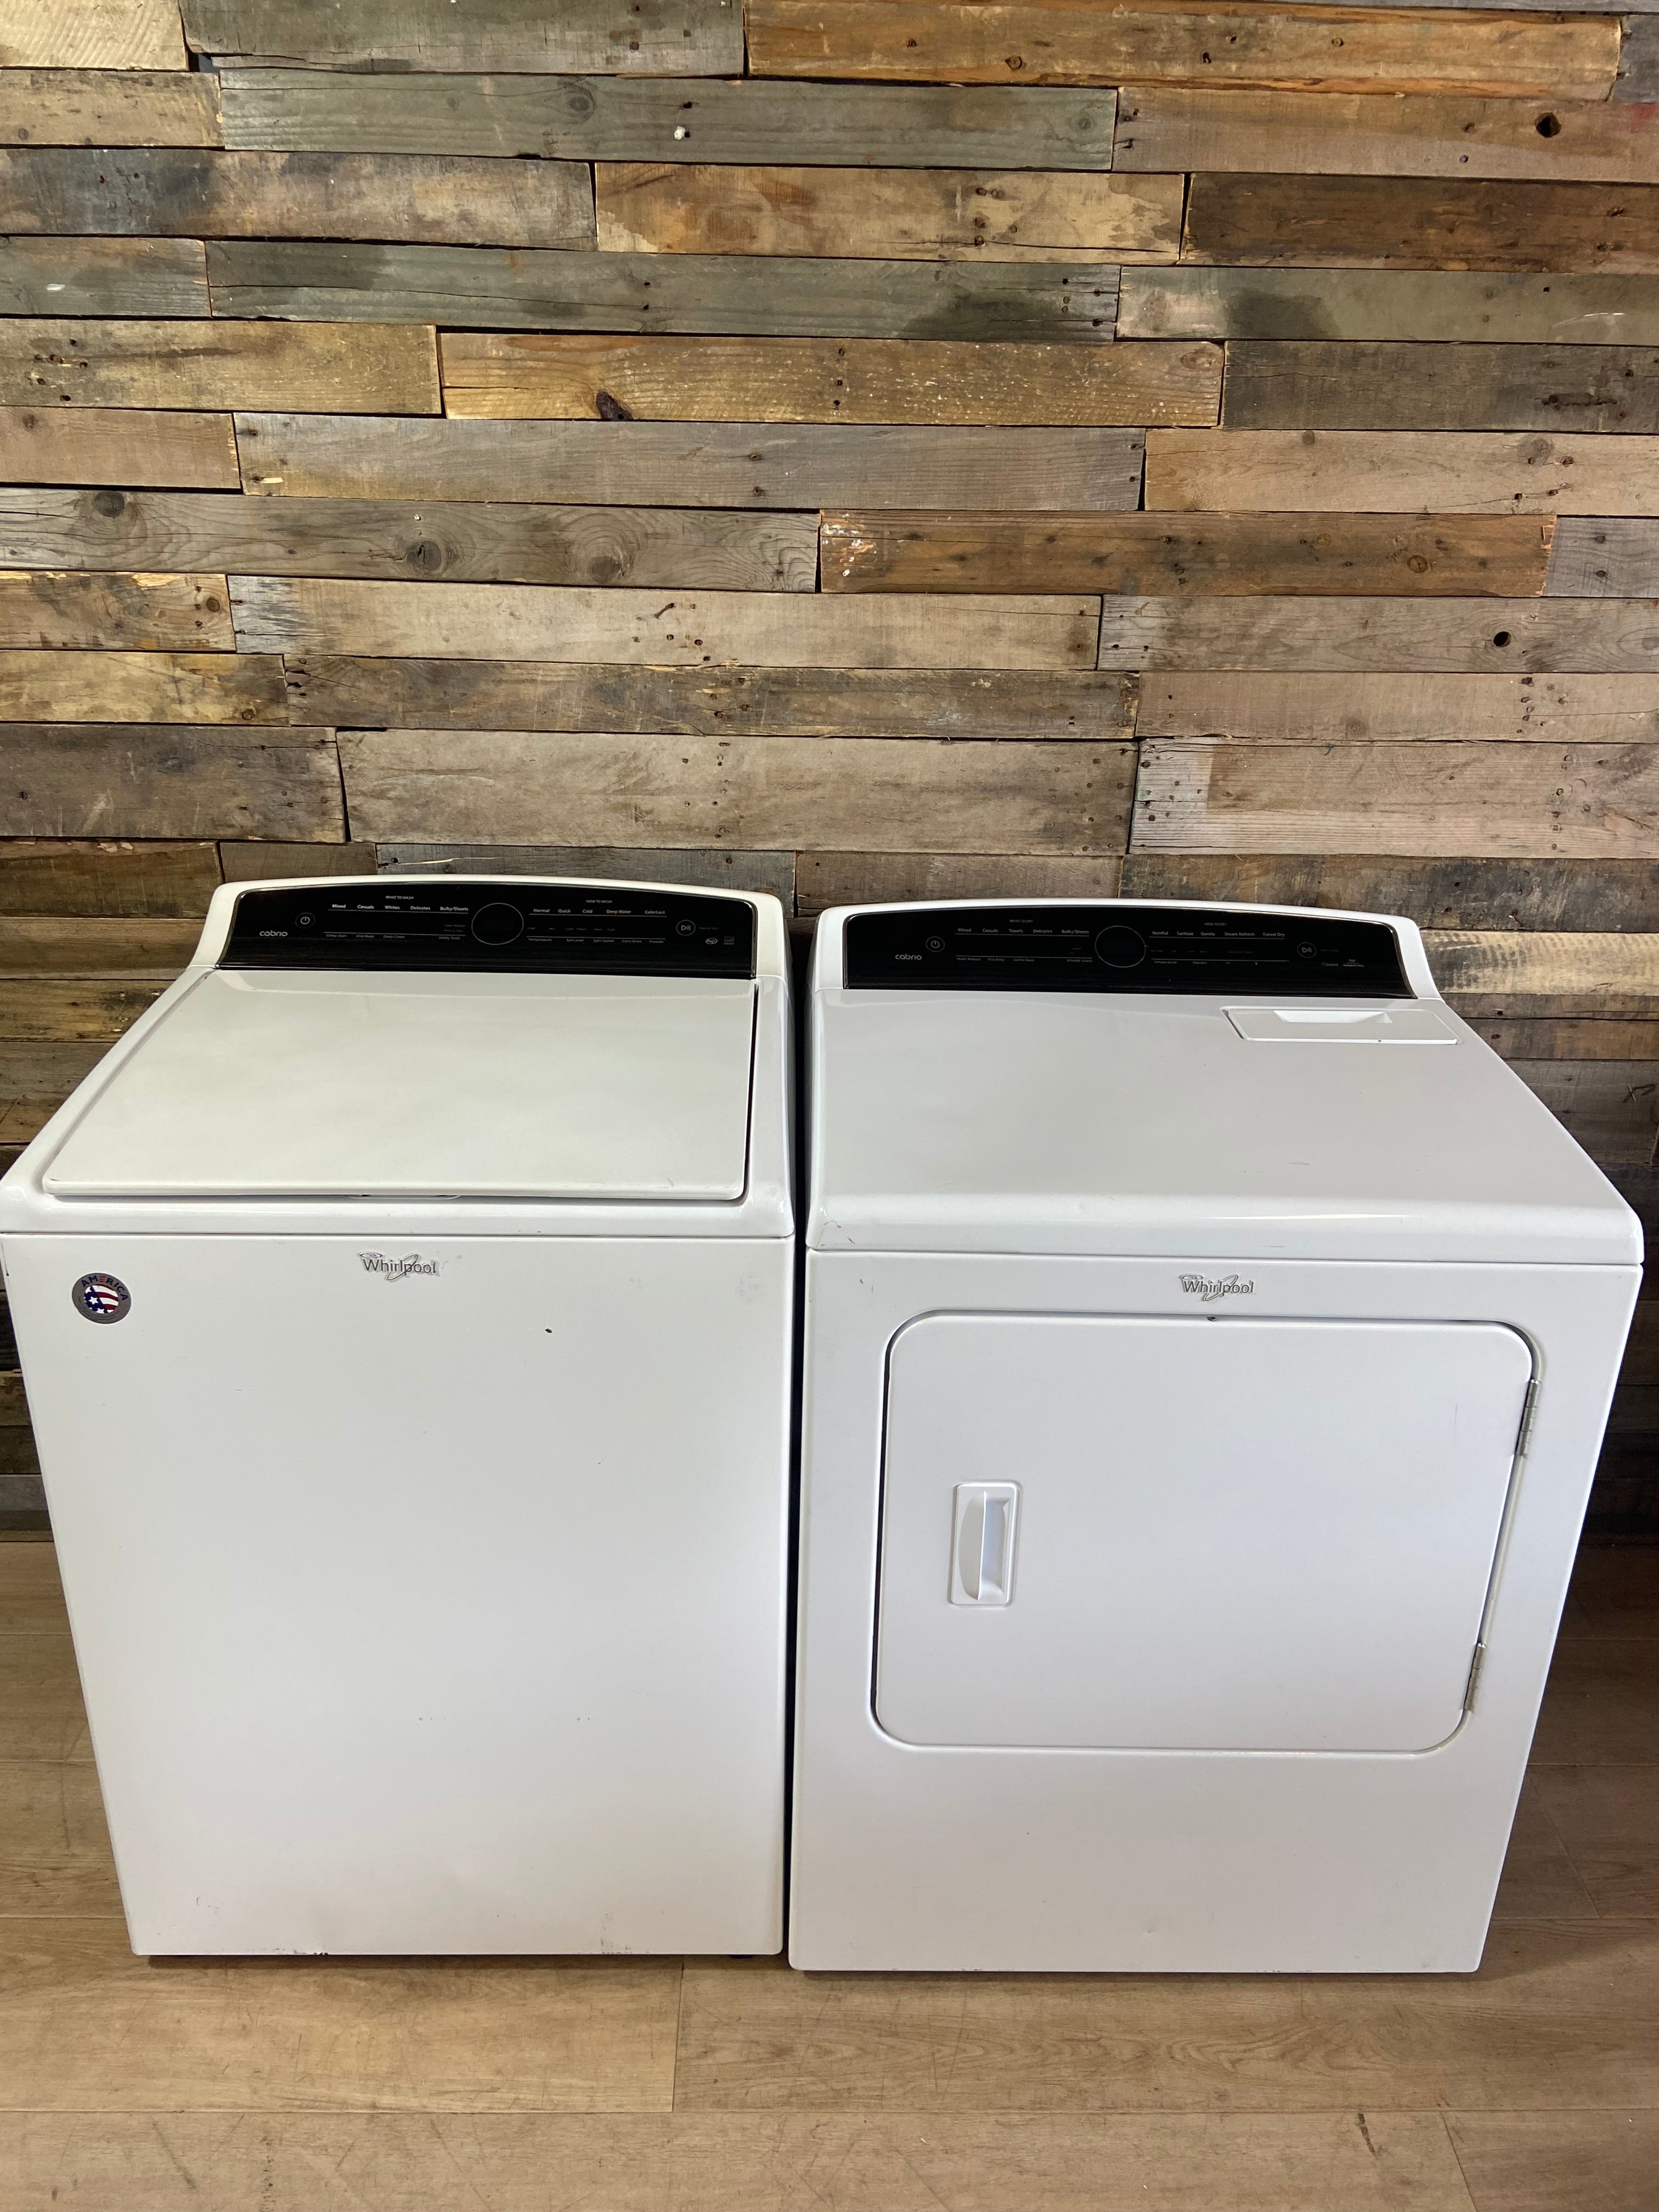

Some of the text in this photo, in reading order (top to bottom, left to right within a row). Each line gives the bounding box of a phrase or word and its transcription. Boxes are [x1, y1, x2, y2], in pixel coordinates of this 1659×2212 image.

[362, 1255, 437, 1278] Whirlpool
[81, 1275, 128, 1301] AMERICA
[1183, 1277, 1255, 1297] Whirlpool
